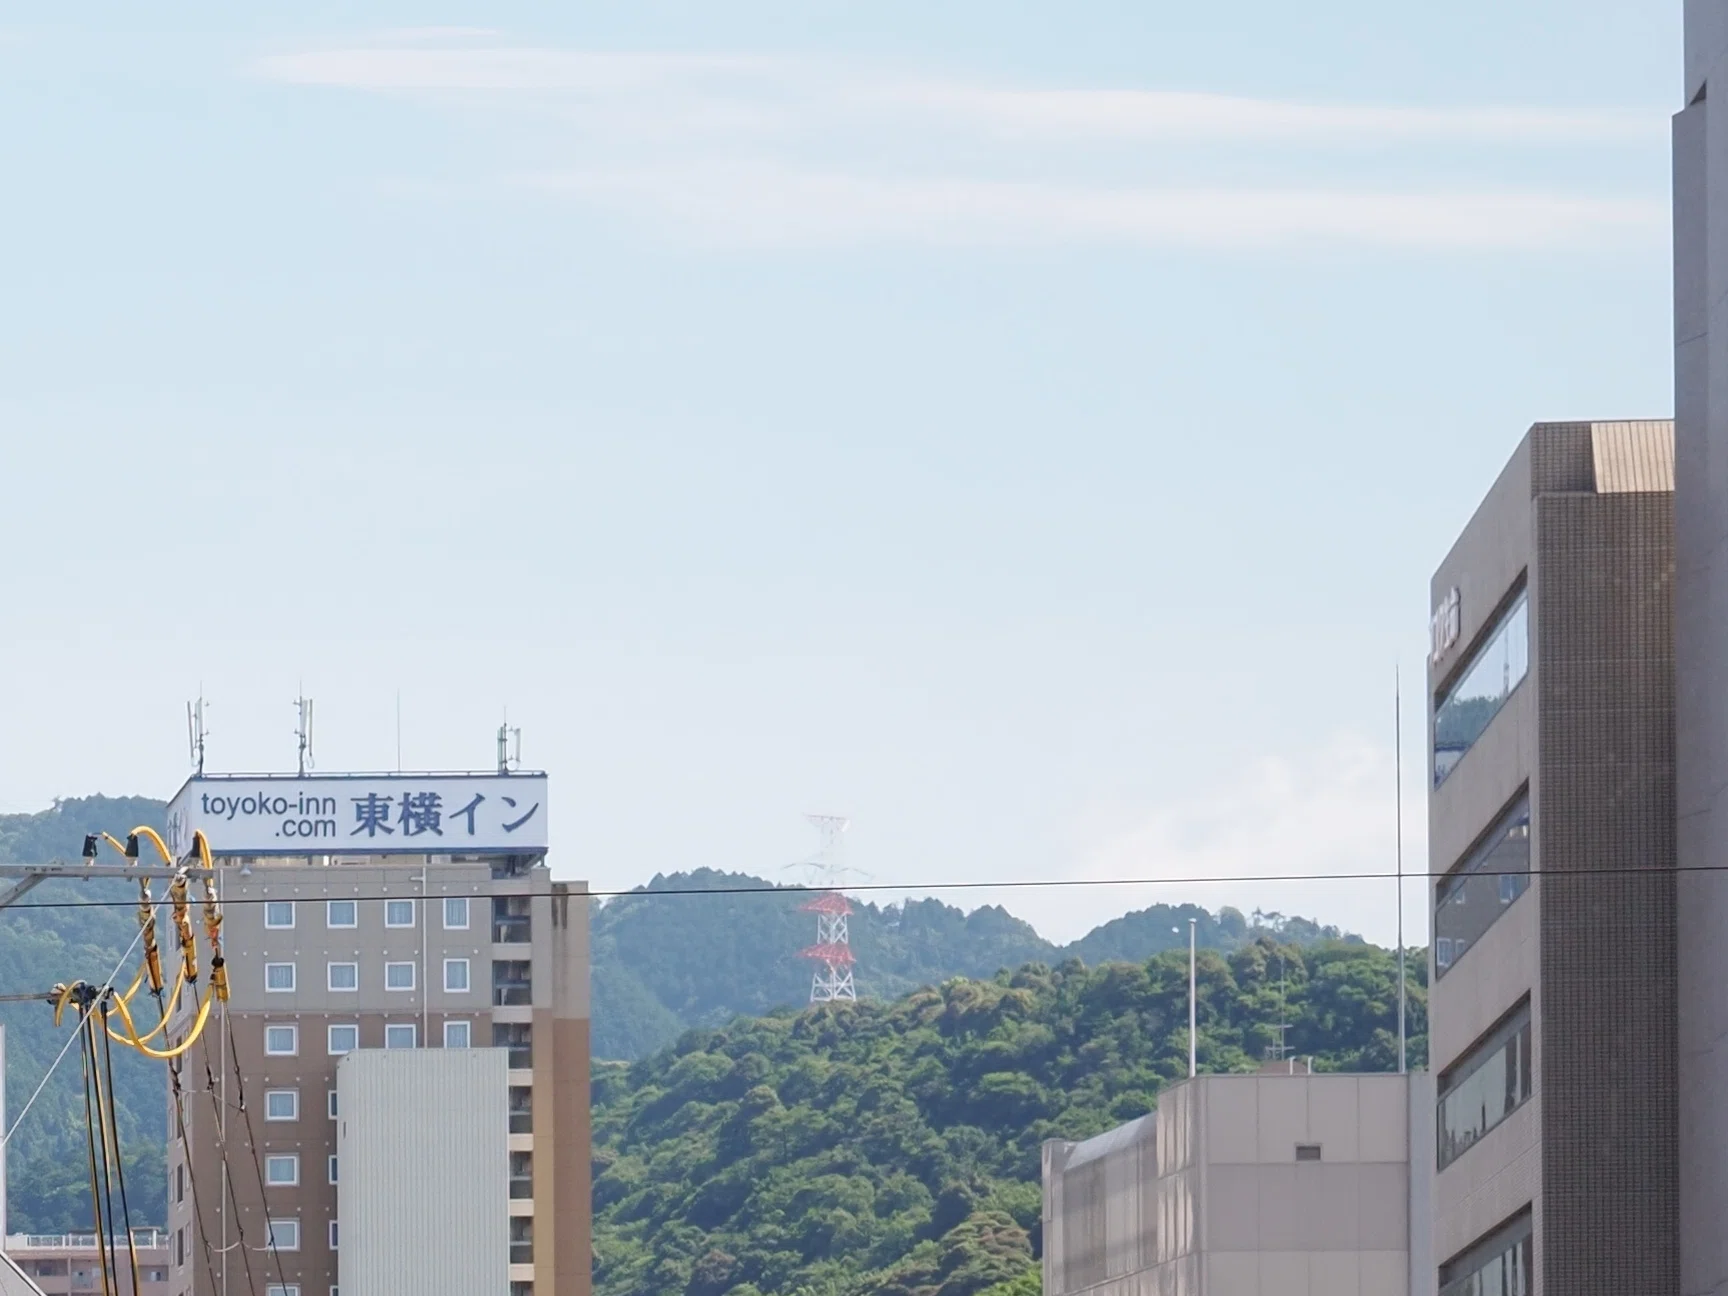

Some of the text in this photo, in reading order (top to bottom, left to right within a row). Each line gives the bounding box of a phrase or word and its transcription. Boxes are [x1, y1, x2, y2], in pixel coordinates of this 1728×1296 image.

[202, 792, 337, 820] toyoko-inn
[349, 791, 539, 837] 東横イン
[274, 818, 337, 838] .com
